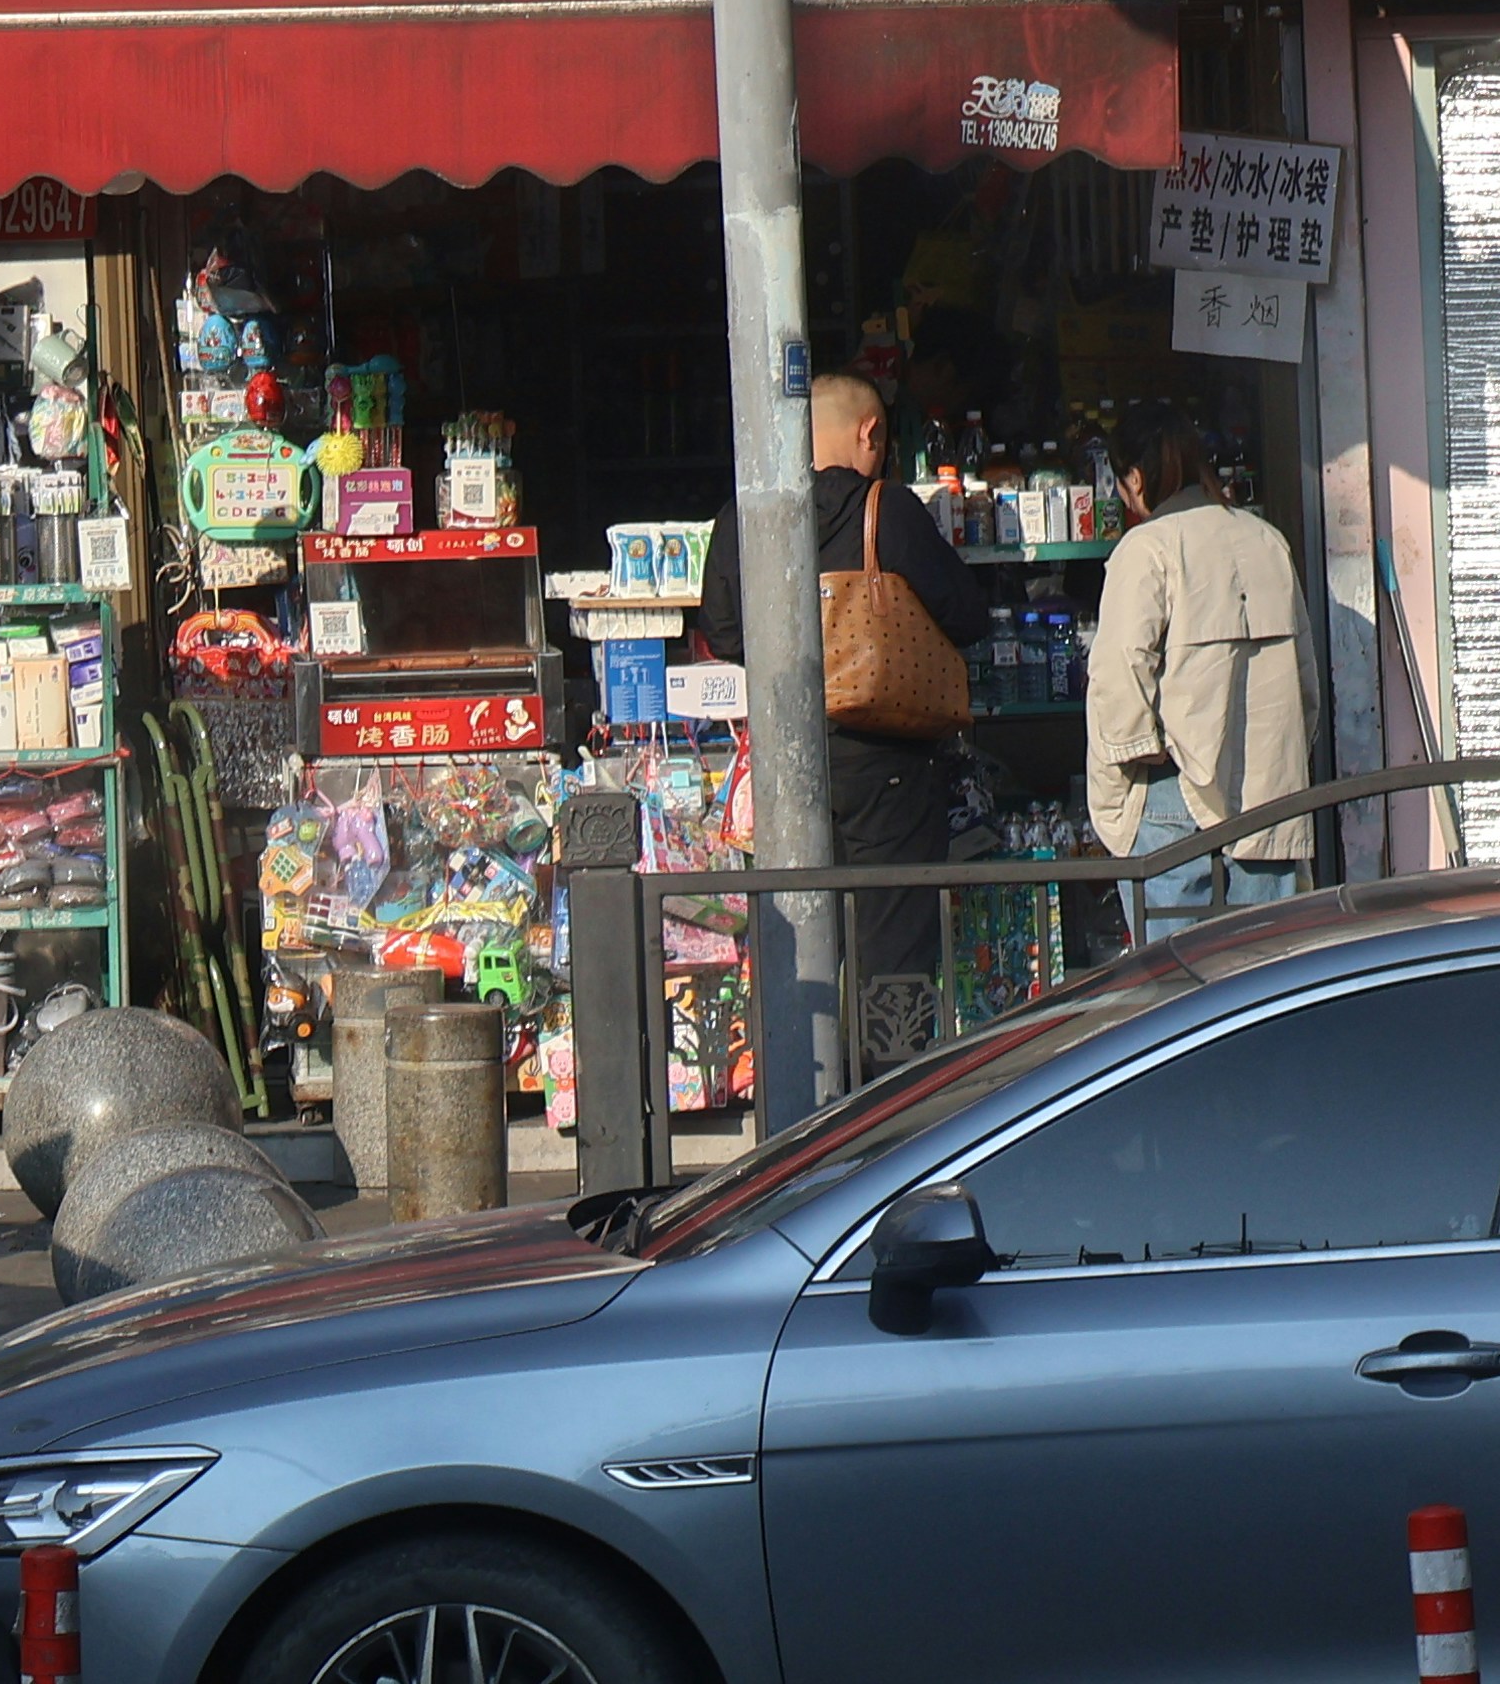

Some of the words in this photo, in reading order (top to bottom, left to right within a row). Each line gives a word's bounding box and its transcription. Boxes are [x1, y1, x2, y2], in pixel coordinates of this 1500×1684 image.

[1159, 204, 1325, 266] 产垫/护理垫
[1199, 284, 1280, 329] 香烟
[356, 723, 450, 748] 烤香肠
